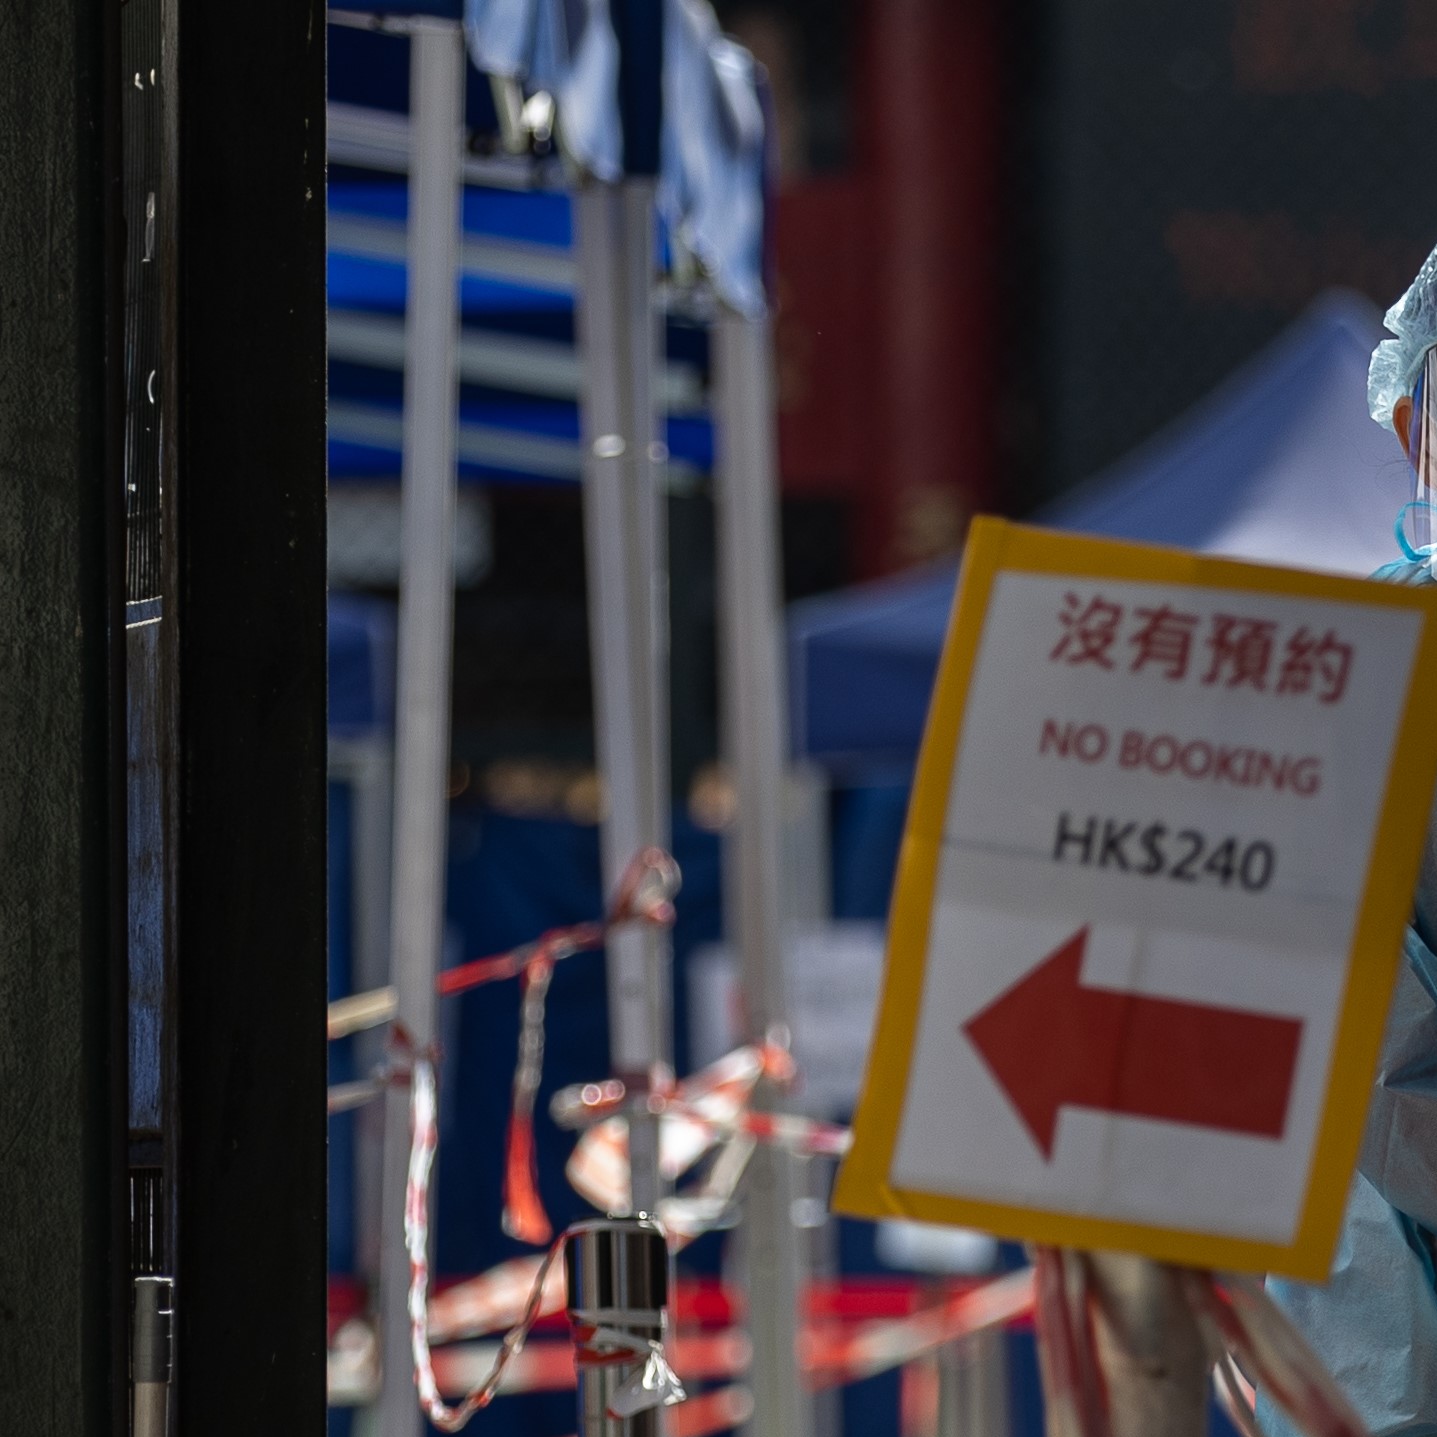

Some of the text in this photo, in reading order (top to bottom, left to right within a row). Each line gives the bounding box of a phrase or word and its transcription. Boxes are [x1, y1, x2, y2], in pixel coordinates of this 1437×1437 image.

[1049, 592, 1356, 704] 沒有預約
[1040, 719, 1323, 797] NO BOOKING
[1052, 811, 1276, 893] HK$240
